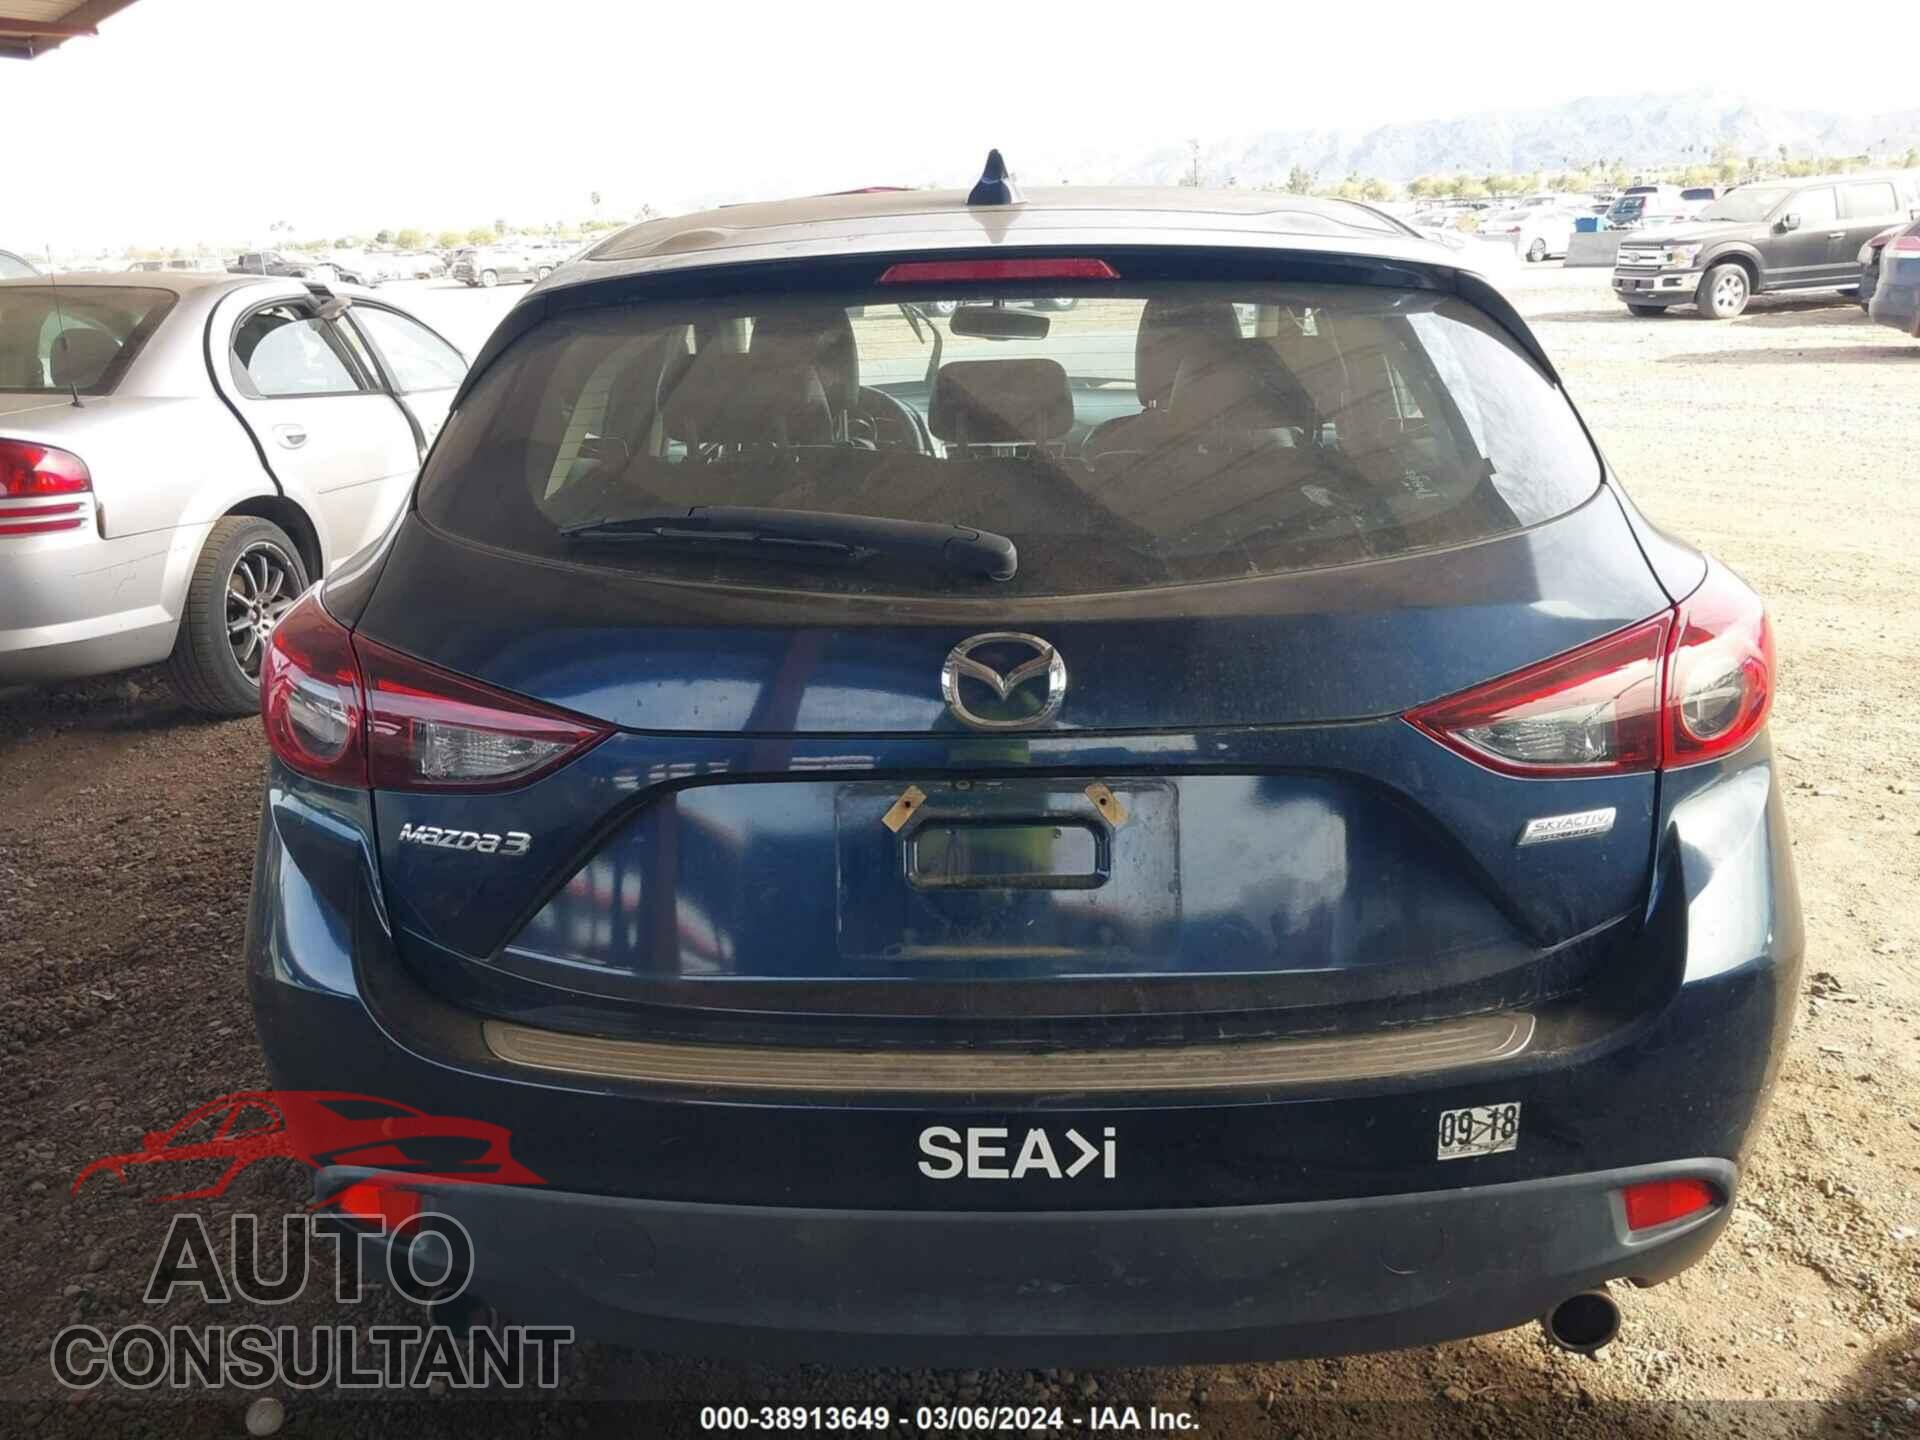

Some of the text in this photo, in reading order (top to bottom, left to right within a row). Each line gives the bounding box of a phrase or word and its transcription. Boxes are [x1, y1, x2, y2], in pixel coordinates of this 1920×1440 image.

[1532, 814, 1610, 833] SKYACTIV
[1441, 1105, 1517, 1147] 09 18
[917, 1126, 1116, 1179] SEA>i
